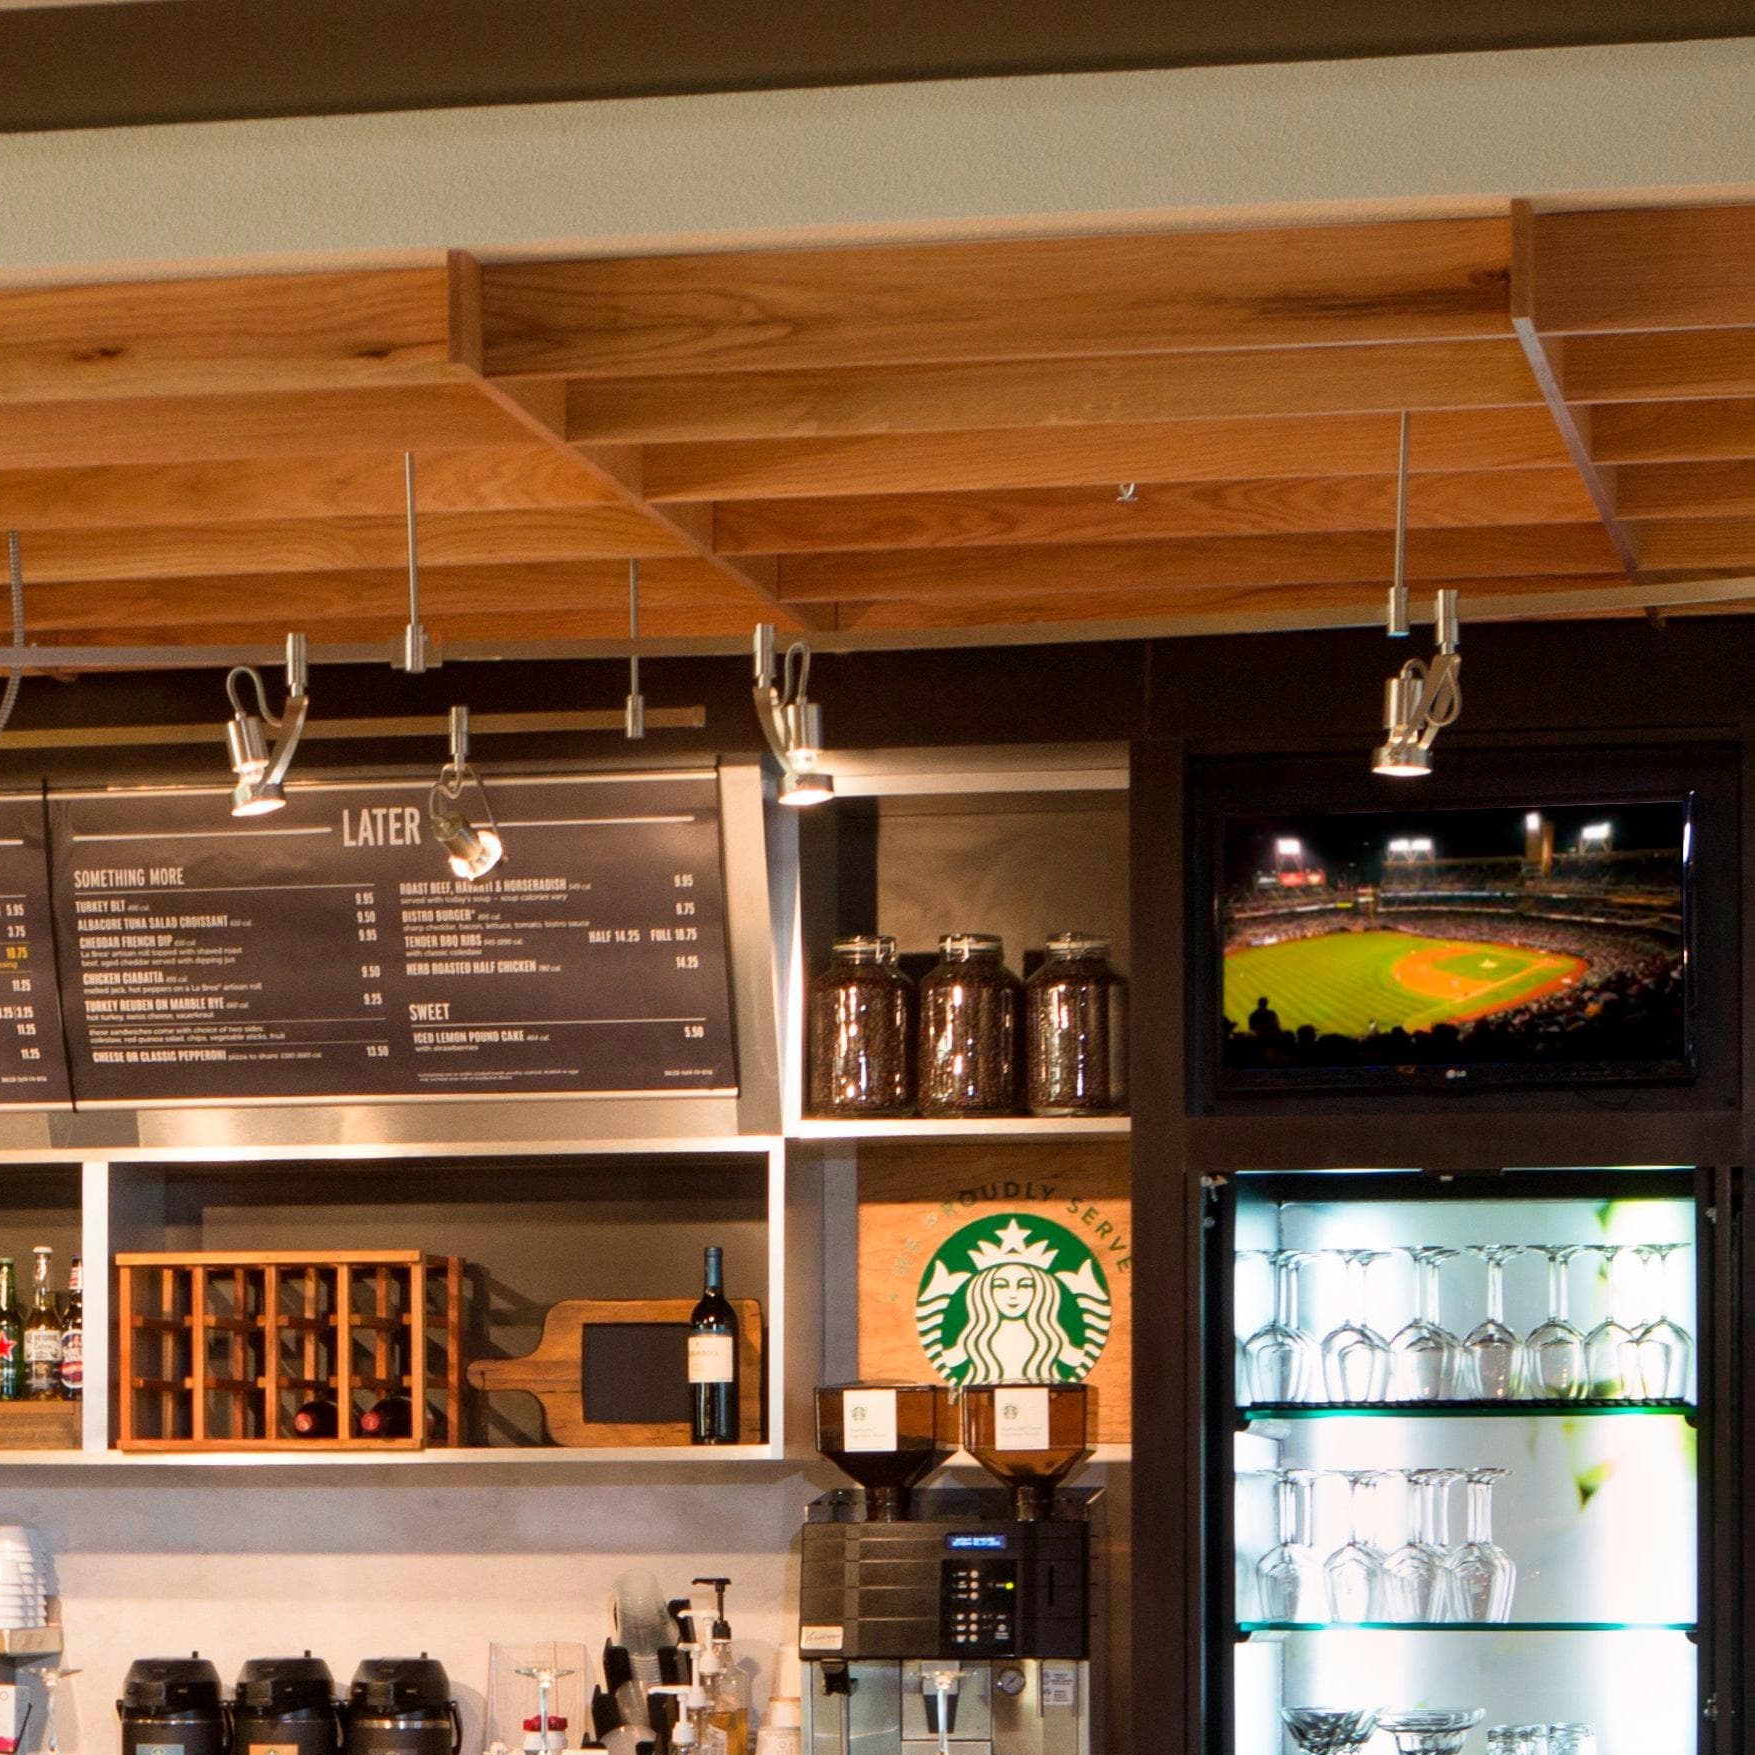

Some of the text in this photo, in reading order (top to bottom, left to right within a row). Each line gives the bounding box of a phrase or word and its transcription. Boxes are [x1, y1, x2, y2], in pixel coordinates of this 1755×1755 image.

[343, 806, 421, 849] LATER
[74, 868, 184, 888] SOMETHING MORE
[76, 900, 125, 913] TURKEY BLT
[78, 915, 228, 931] ALBACORE TUNA SALAD CROISSANT
[357, 911, 375, 923] 9.50
[8, 925, 26, 938] 3.75
[589, 931, 611, 943] HALF
[615, 930, 640, 942] 14.25
[651, 929, 672, 941] FULL
[79, 935, 172, 949] CHEDDAR FRENCH DIP
[405, 934, 481, 947] TENDER BBQ RIBS
[406, 960, 536, 975] HERB ROASTED HALF CHICKEN
[676, 956, 698, 968] 14.25
[83, 971, 164, 985] CHICKEN CIABATTA
[362, 966, 380, 978] 9.50
[12, 979, 31, 992] 11.25
[85, 997, 224, 1012] TURKEY REUBEN ON MARBLE RYE
[409, 1003, 450, 1021] SWEET
[17, 1024, 36, 1035] 11.25
[413, 1030, 524, 1044] ICED LEMON POUND CAKE
[21, 1048, 40, 1059] 11.25
[367, 1046, 389, 1057] 13.50
[927, 1181, 1056, 1230] PROUDLY
[1066, 1196, 1132, 1274] SERVE
